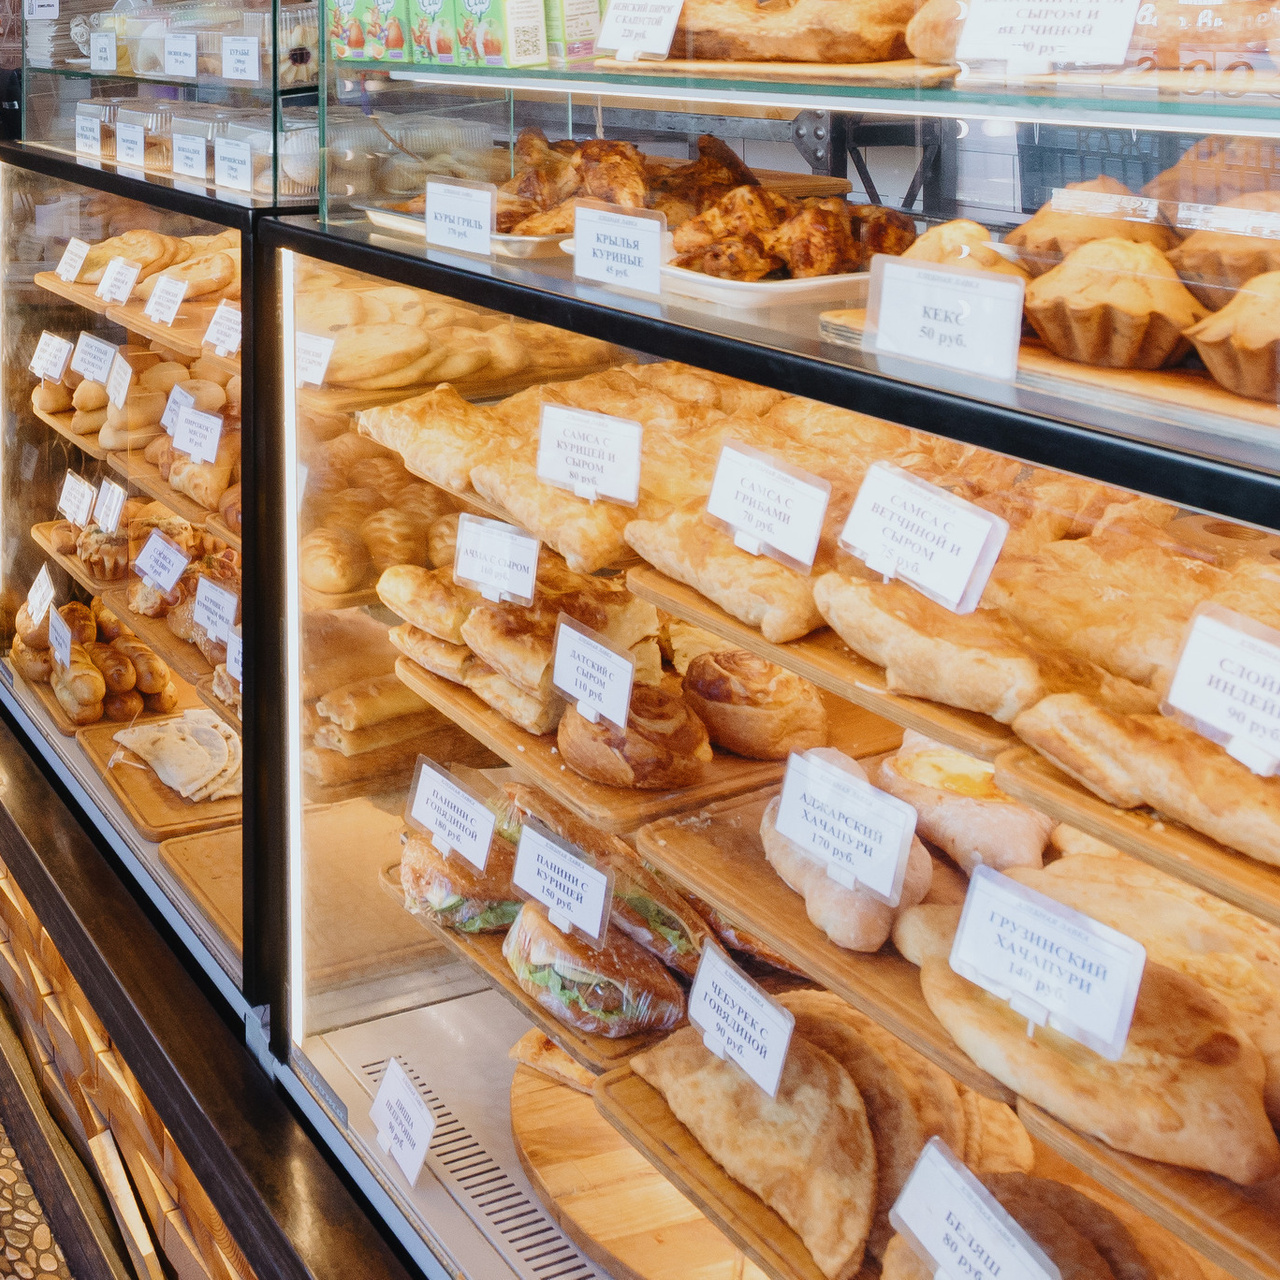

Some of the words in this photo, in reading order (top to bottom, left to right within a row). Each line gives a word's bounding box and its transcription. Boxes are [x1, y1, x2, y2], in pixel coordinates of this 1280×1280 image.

[434, 212, 456, 225] КУРЫ
[456, 216, 483, 231] ГРИЛЬ
[592, 247, 644, 268] КУРИНЫЕ
[596, 232, 640, 251] КРЫЛЬЯ
[919, 325, 935, 341] 50
[938, 332, 967, 349] руб.
[184, 418, 209, 430] ПИРОЖОК
[562, 428, 602, 445] САМСА
[555, 440, 605, 462] КУРИЦЕЙ
[607, 453, 616, 464] И
[565, 456, 605, 474] СЫРОМ
[580, 473, 599, 487] руб.
[740, 477, 783, 504] САМСА
[784, 496, 794, 509] С
[734, 489, 792, 526] ГРИБАМИ
[743, 509, 755, 523] 70
[755, 515, 776, 535] руб.
[890, 494, 939, 527] САМСА
[942, 520, 955, 534] С
[871, 502, 947, 549] ВЕТЧИНОЙ
[948, 543, 962, 556] И
[882, 527, 935, 563] СЫРОМ
[498, 557, 530, 575] СЫРОМ
[570, 650, 607, 677] ДАТСКИЙ
[607, 671, 615, 680] С
[576, 665, 607, 689] СЫРОМ
[1219, 658, 1280, 696] СЛОЙ
[574, 678, 588, 693] 110
[589, 688, 604, 704] руб.
[1206, 674, 1280, 719] ИНДЕЙ
[425, 797, 478, 841] ГОВЯДИНОЙ
[432, 790, 468, 821] ПАНИНИ
[469, 816, 477, 827] С
[799, 792, 884, 845] АДЖАРСКИЙ
[448, 828, 462, 844] руб.
[800, 810, 874, 858] ХАЧАПУРИ
[810, 832, 830, 851] 170
[832, 844, 856, 866] руб.
[536, 854, 579, 886] ПАНИНИ
[581, 881, 589, 892] С
[536, 867, 583, 904] КУРИЦЕЙ
[541, 885, 555, 901] 150
[556, 894, 574, 913] руб.
[988, 911, 1108, 982] ГРУЗИНСКИЙ
[994, 934, 1092, 995] ХАЧАПУРИ
[1034, 978, 1067, 1003] руб.
[709, 981, 757, 1032] ЧЕБУРЕК
[758, 1025, 769, 1038] С
[702, 993, 768, 1059] ГОВЯДИНОЙ
[715, 1022, 726, 1038] 90
[726, 1033, 745, 1057] руб.
[395, 1098, 415, 1130] ПИЦЦА
[393, 1133, 404, 1151] руб.
[943, 1233, 959, 1254] 80
[946, 1211, 1001, 1277] БЕЛЯШ
